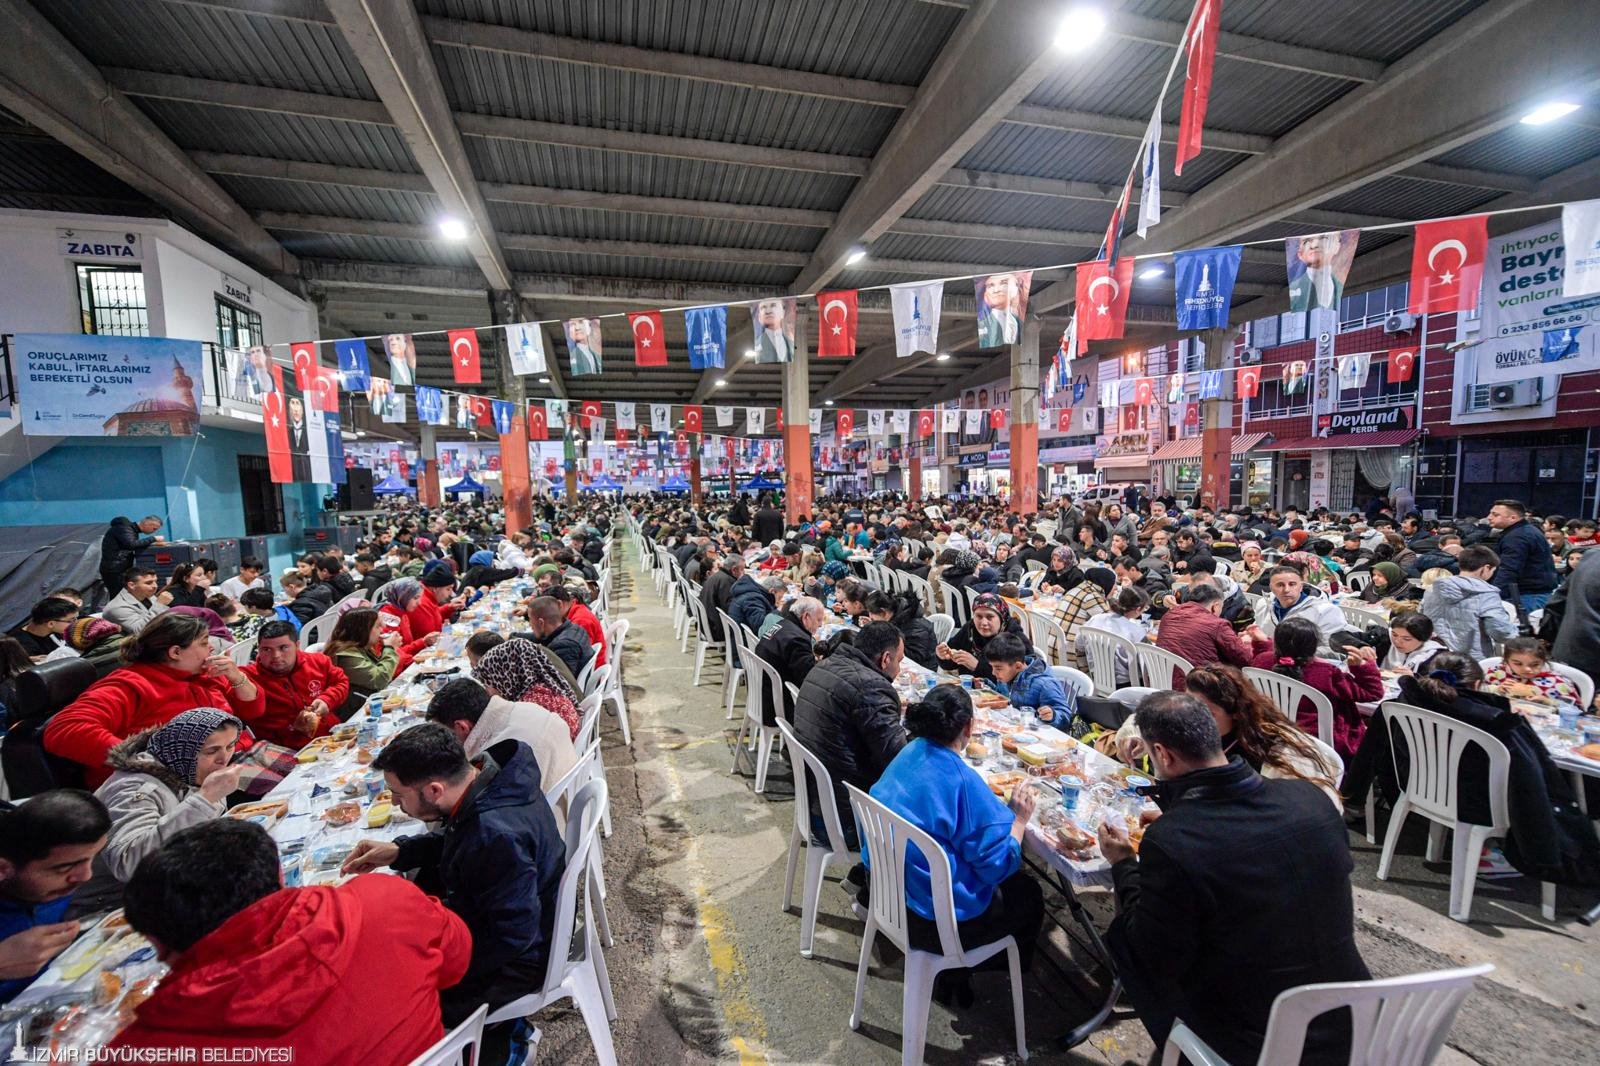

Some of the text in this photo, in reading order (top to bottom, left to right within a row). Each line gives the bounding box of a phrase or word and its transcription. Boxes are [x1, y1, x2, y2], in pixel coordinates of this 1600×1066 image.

[67, 242, 135, 257] ZABITA
[1499, 265, 1565, 293] dest
[225, 284, 251, 304] ZABITA
[28, 351, 108, 362] ORUÇLARIMIZ
[29, 362, 152, 374] KABUL, İFTARLARIMIZ
[30, 373, 133, 384] BEREKETLİ OLSUN
[1332, 408, 1398, 427] Devland
